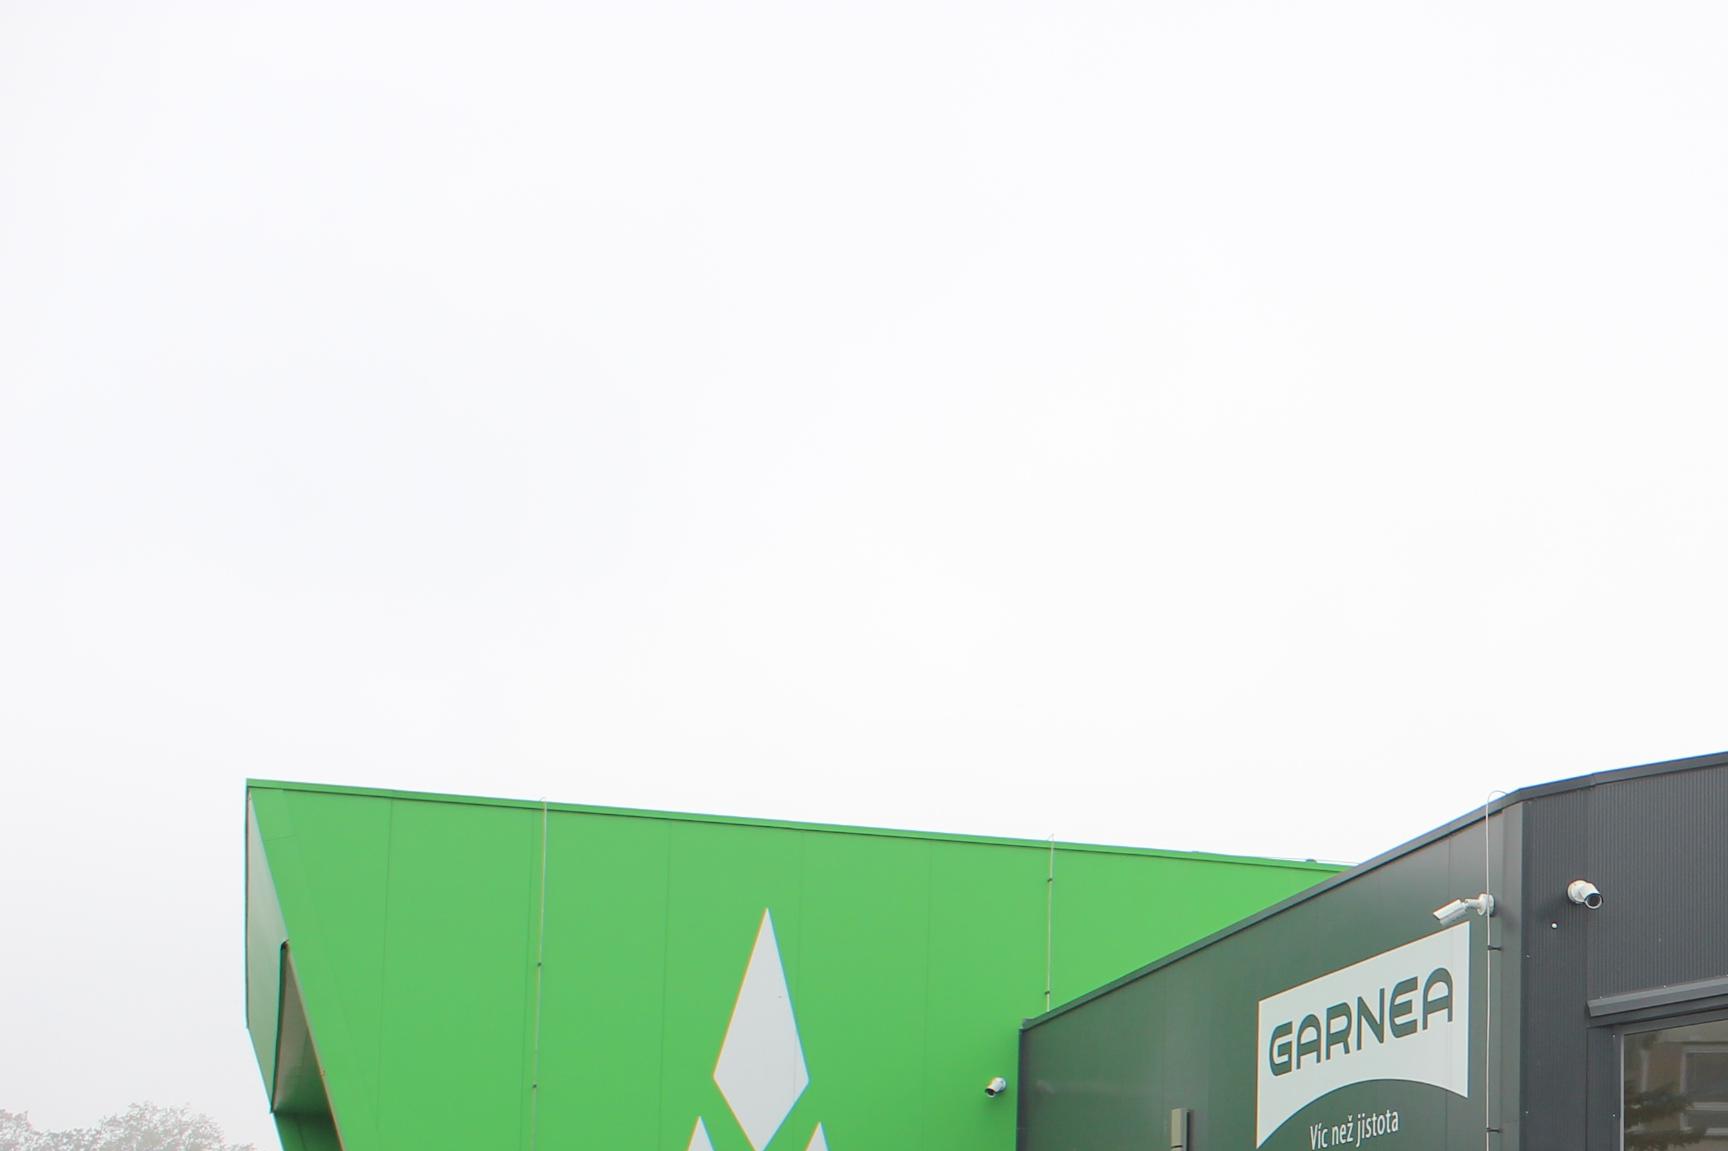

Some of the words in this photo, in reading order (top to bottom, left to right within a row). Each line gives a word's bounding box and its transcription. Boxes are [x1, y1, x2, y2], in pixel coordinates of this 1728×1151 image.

[1269, 967, 1453, 1077] GARNEA
[1310, 1120, 1328, 1150] Víc
[1331, 1115, 1353, 1145] než
[1355, 1109, 1399, 1148] jistota
